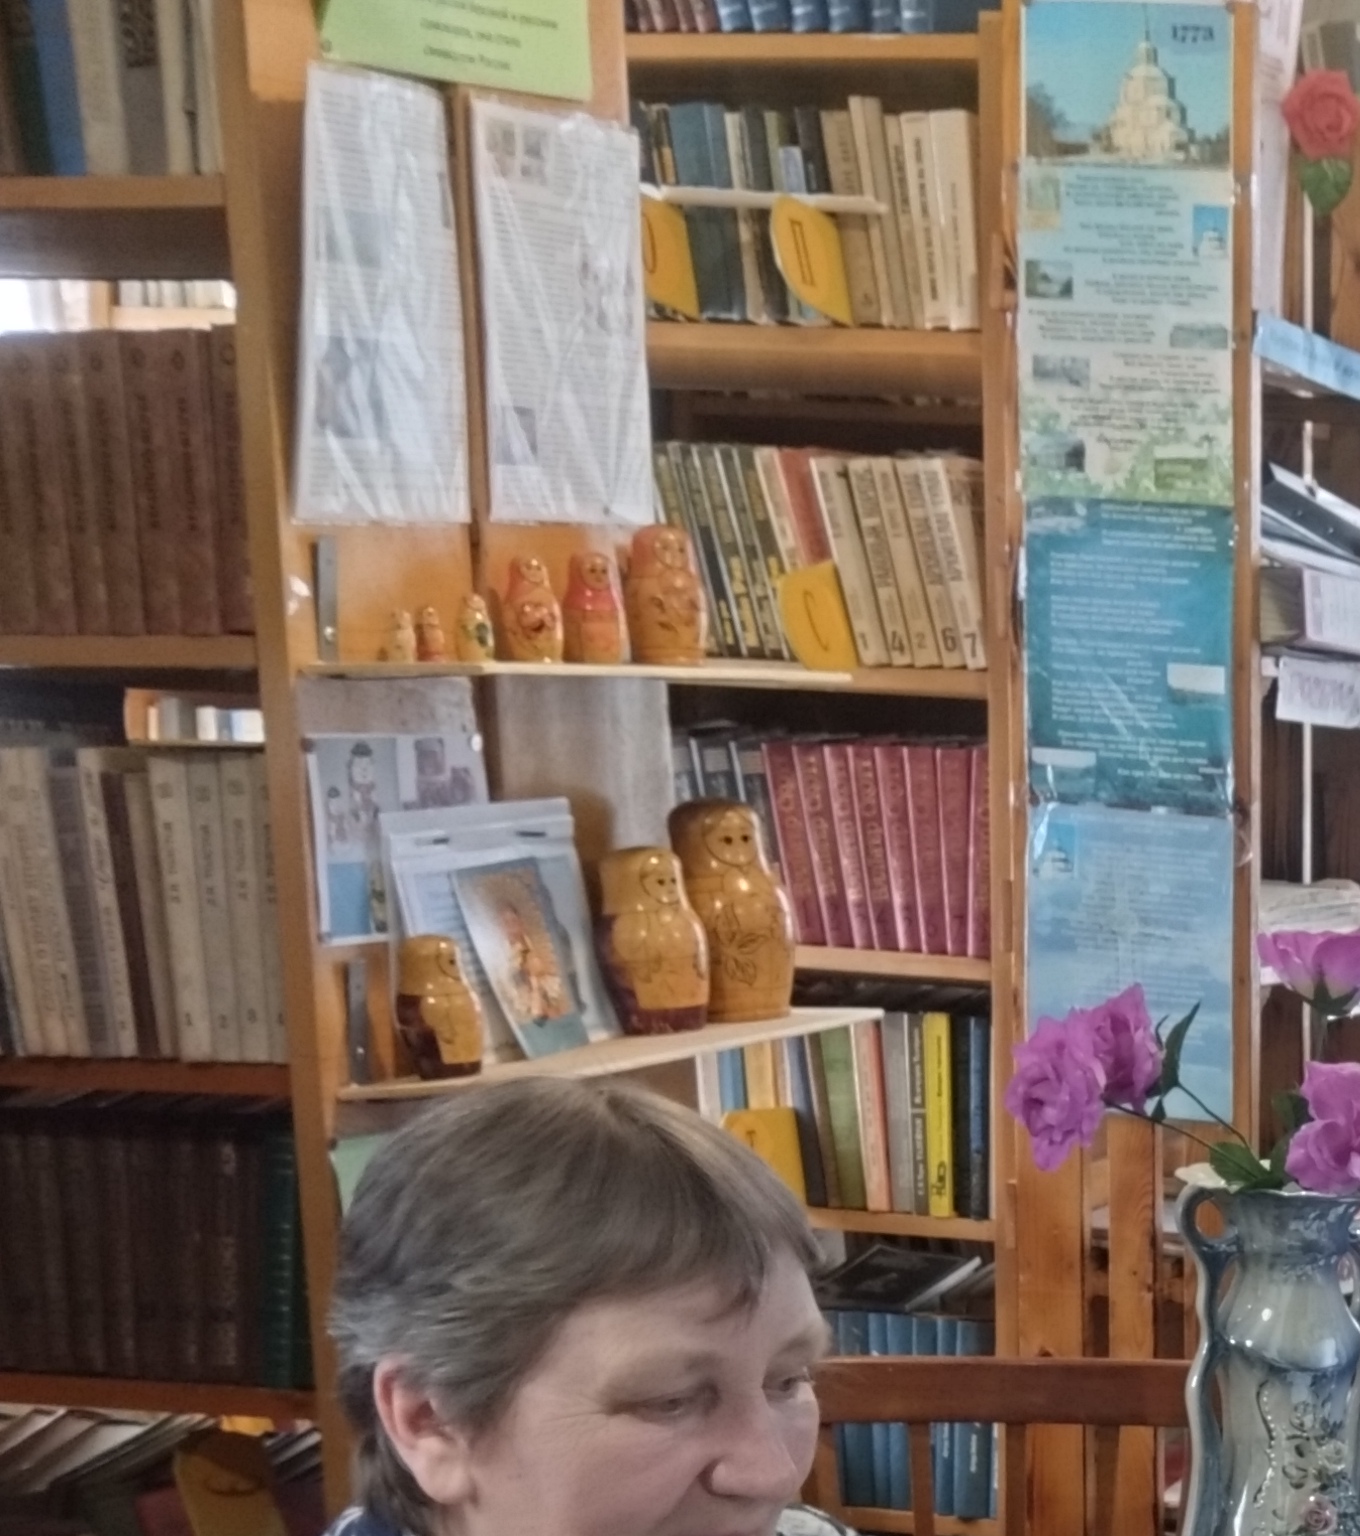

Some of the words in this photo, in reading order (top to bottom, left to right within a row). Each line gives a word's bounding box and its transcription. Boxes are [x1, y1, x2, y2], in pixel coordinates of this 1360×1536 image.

[889, 632, 905, 657] 4
[941, 627, 957, 653] 6
[964, 633, 977, 659] 7
